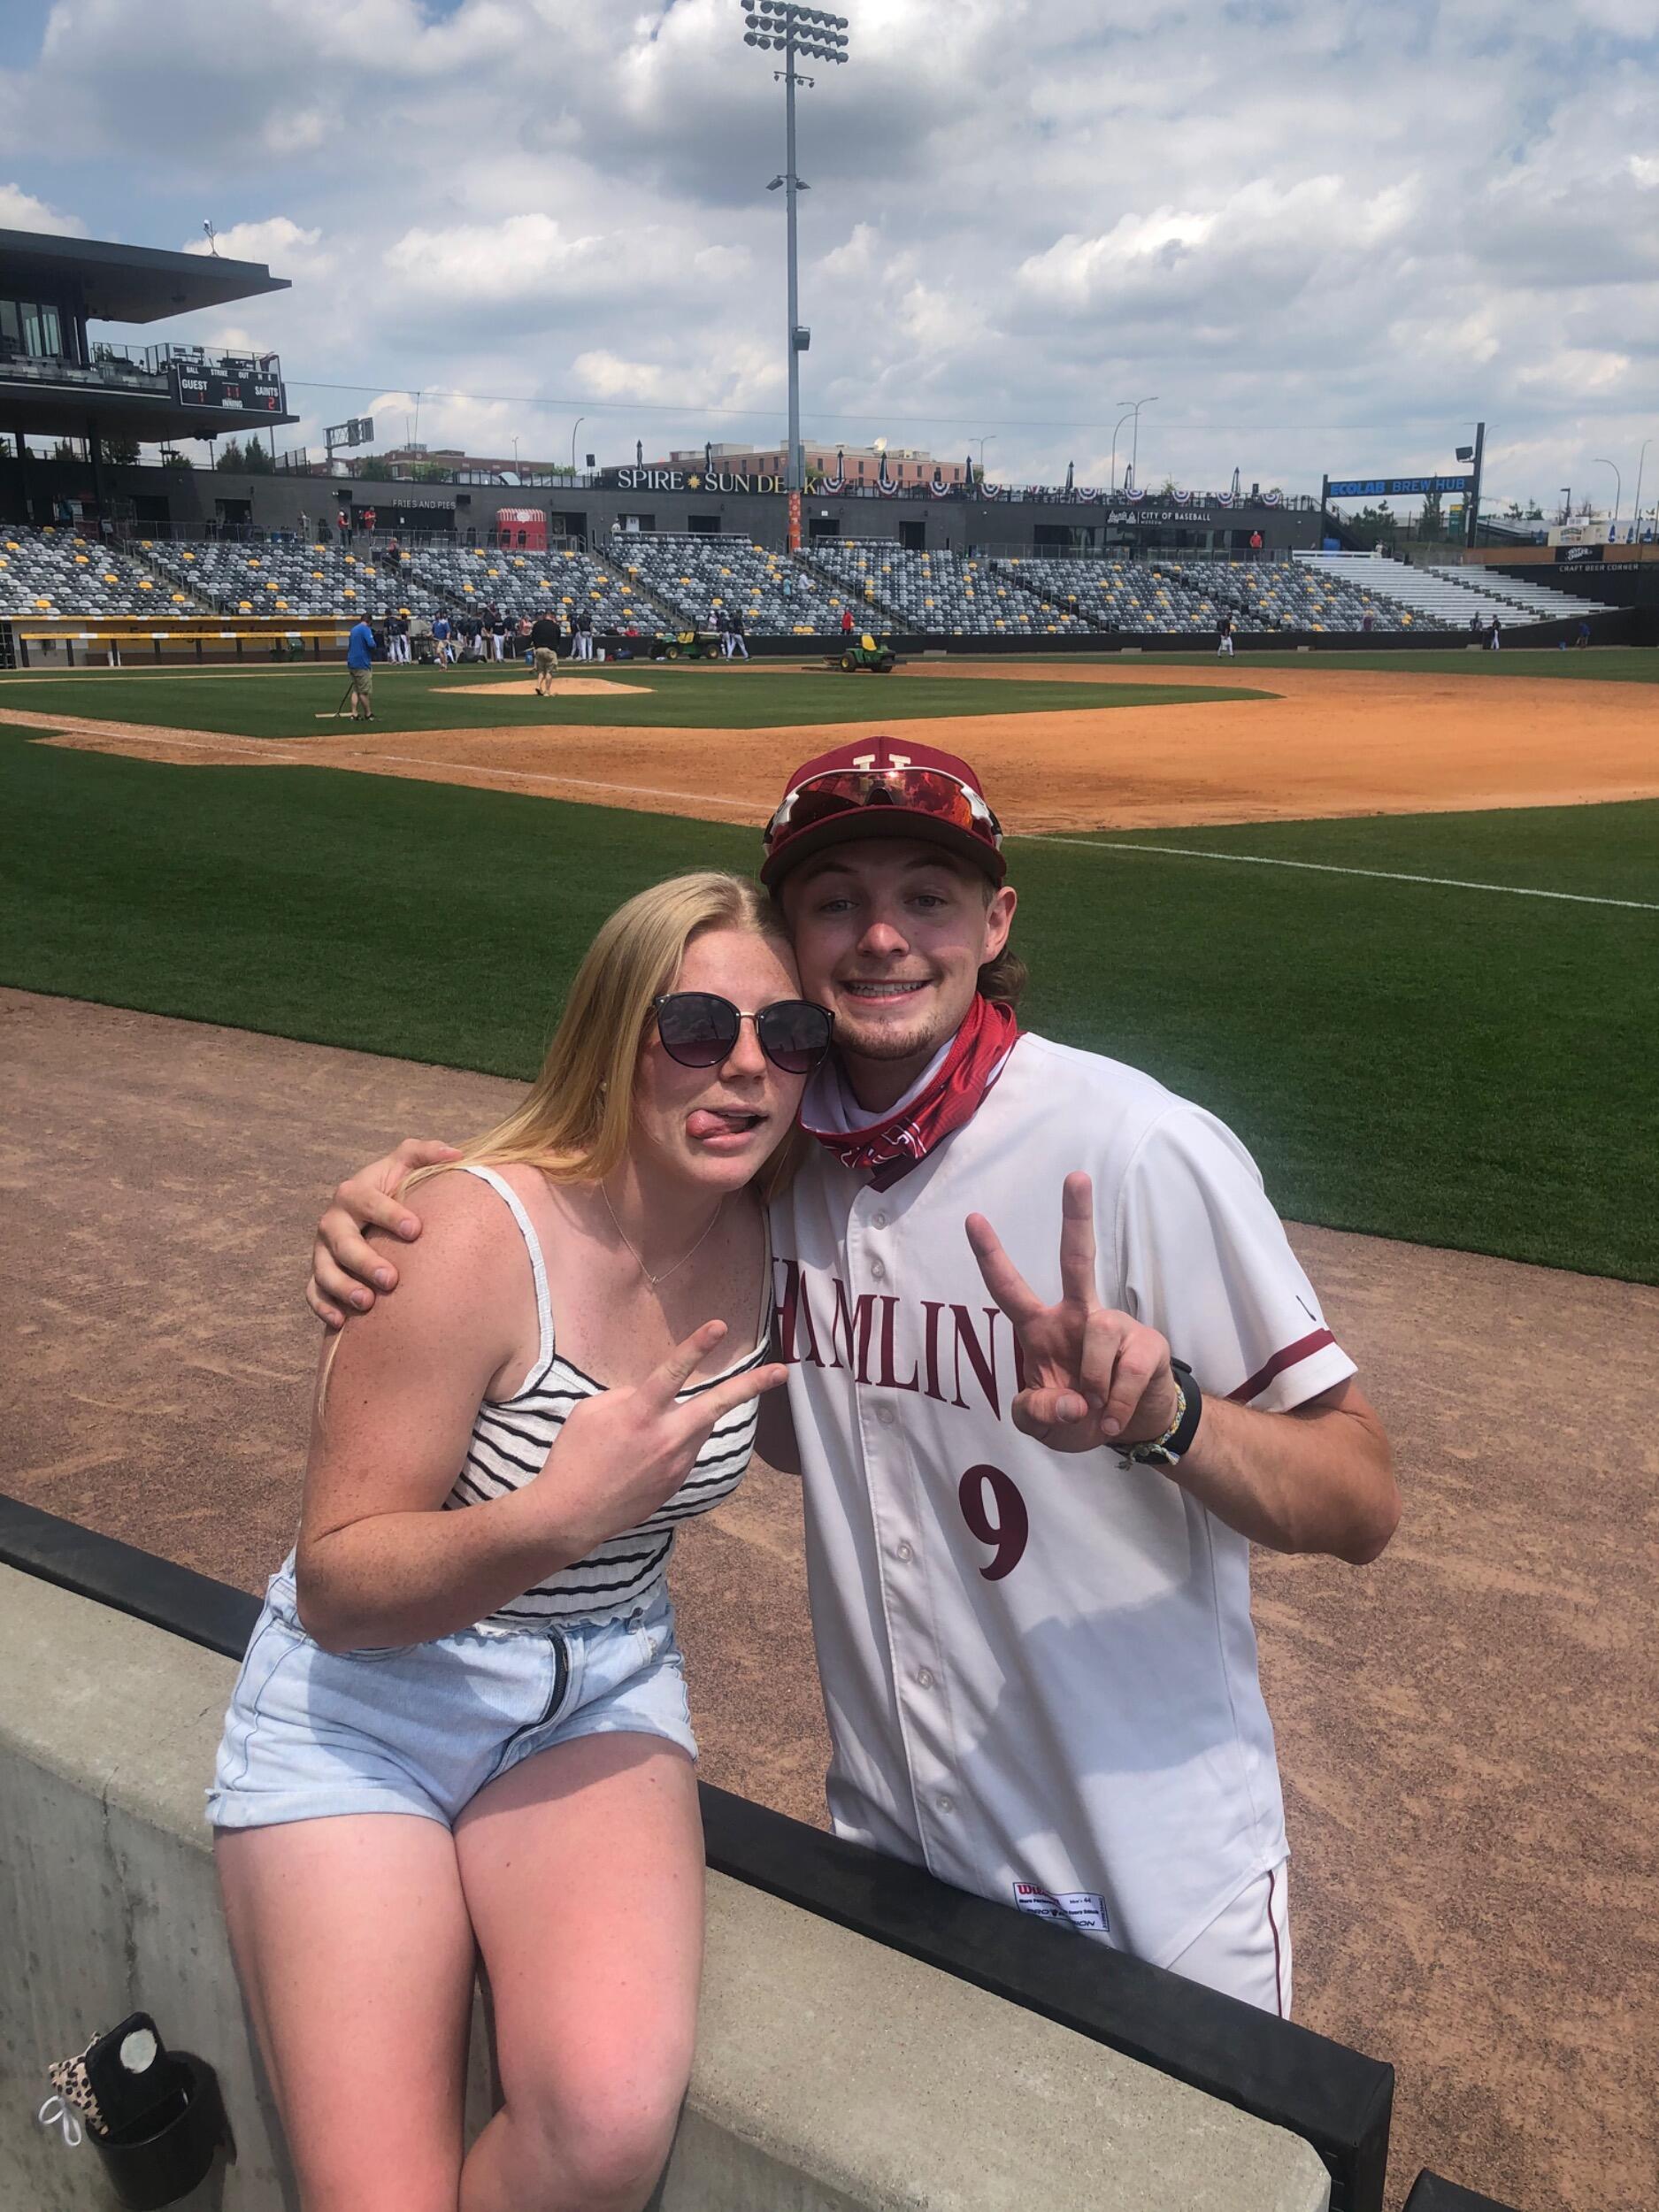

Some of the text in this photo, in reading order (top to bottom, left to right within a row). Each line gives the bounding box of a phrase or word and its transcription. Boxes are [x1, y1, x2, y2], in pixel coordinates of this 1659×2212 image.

[186, 365, 199, 374] BALL
[211, 368, 228, 377] STRIKE
[181, 379, 208, 390] GUEST
[255, 386, 279, 397] SAINTS
[268, 396, 275, 411] 2
[618, 469, 818, 495] SPIRE SUN DEK
[1330, 478, 1464, 496] ECOLAB BREW HUB
[392, 499, 457, 511] FRIES AND PIES
[1141, 511, 1210, 521] CITY OF BASEBALL
[1585, 564, 1605, 572] BEER
[1609, 564, 1640, 572] CORNER
[772, 1256, 1025, 1424] HAMLIN
[958, 1463, 1030, 1582] 9
